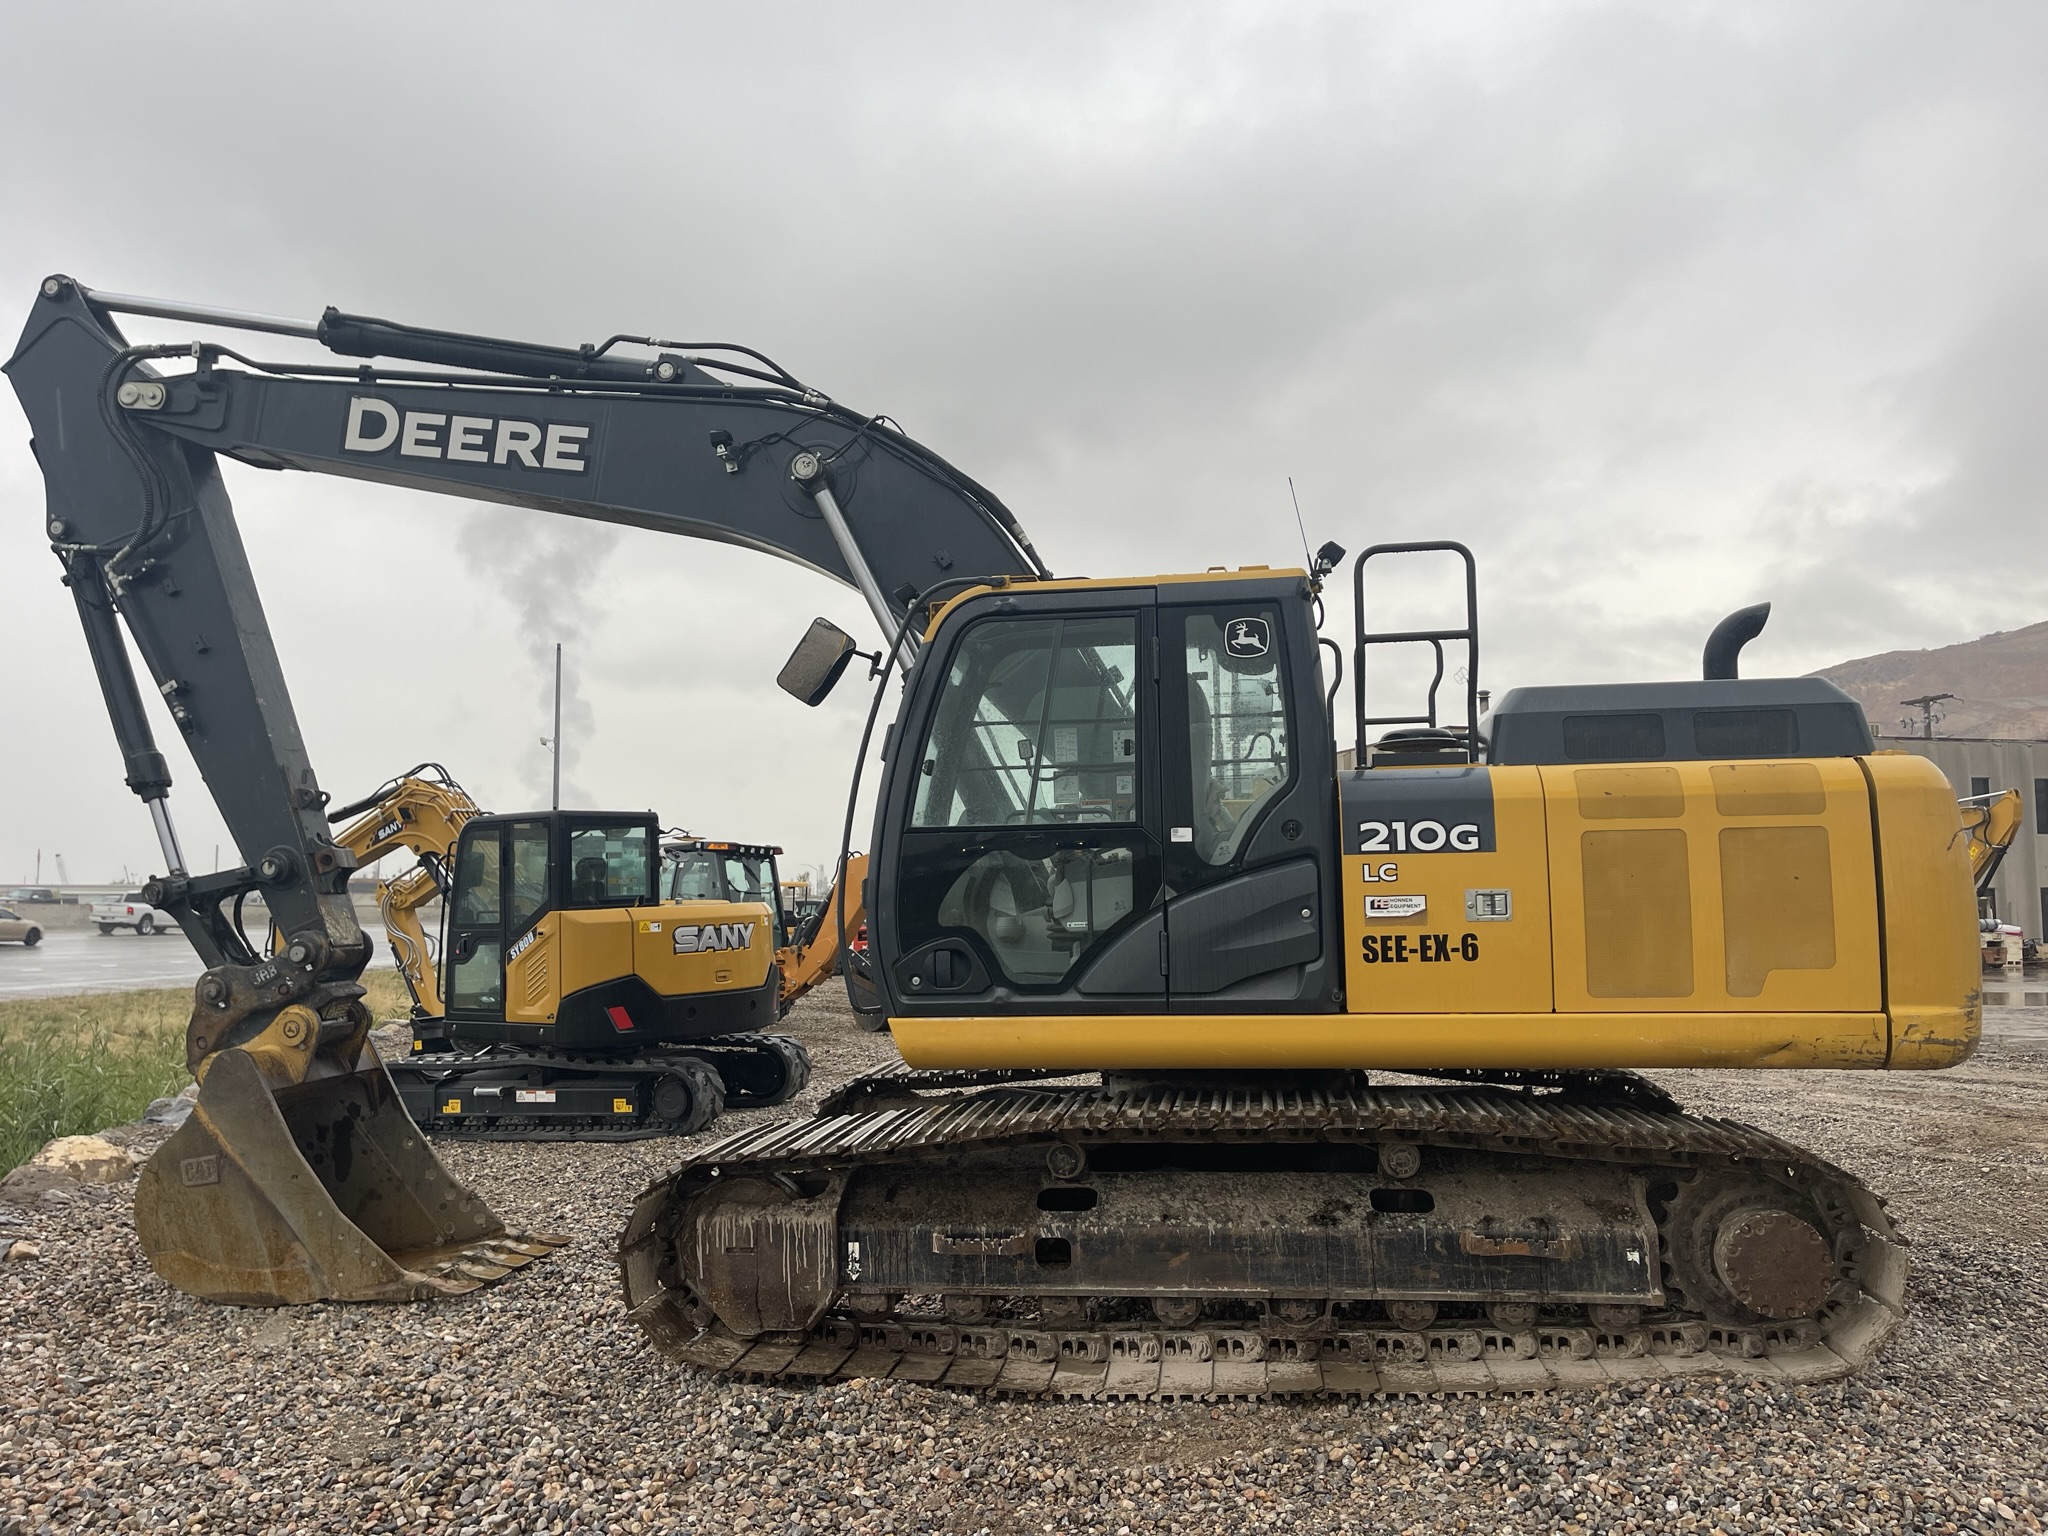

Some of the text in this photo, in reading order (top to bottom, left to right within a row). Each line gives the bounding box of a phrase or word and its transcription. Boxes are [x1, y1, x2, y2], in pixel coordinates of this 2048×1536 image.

[344, 396, 590, 471] DEERE
[1359, 820, 1479, 852] 210G
[1362, 862, 1399, 883] LC
[673, 921, 756, 954] SANY
[1361, 933, 1479, 963] SEE-EX-6
